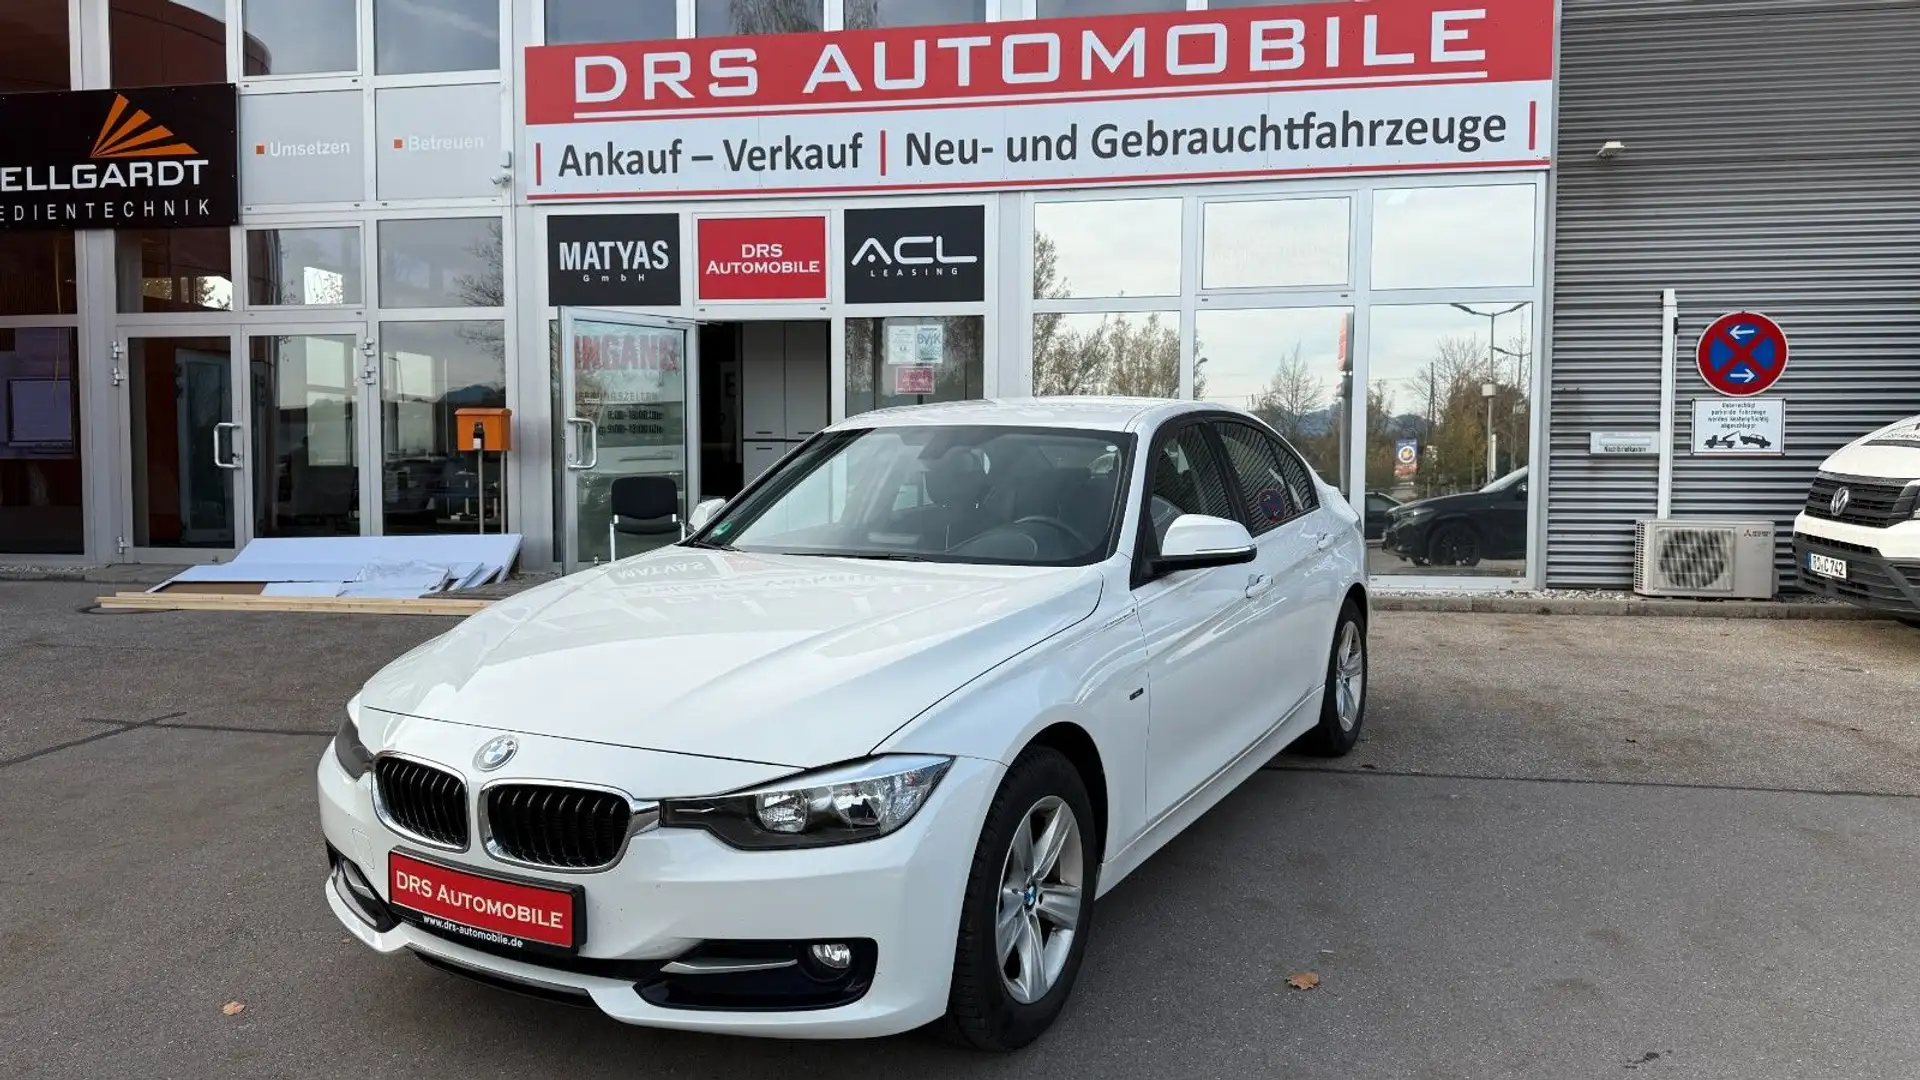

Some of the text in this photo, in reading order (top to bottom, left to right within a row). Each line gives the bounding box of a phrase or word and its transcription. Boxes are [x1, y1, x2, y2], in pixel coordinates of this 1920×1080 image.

[575, 8, 1487, 103] DRS AUTOMOBILE
[270, 140, 350, 157] Umsetzen
[408, 135, 484, 152] Betreuen
[905, 110, 1506, 167] Neu- und Gebrauchtfahrzeuge
[558, 138, 683, 177] Ankauf
[722, 132, 863, 172] Verkauf
[1, 159, 209, 192] ELLGARDT
[558, 240, 670, 271] MATYAS
[741, 243, 783, 258] DRS
[851, 235, 977, 266] ACL
[705, 260, 820, 275] AUTOMOBILE
[870, 267, 958, 278] LEASING
[395, 870, 564, 930] DRS AUTOMOBILE
[423, 914, 524, 949] www.drs-automobile.de
